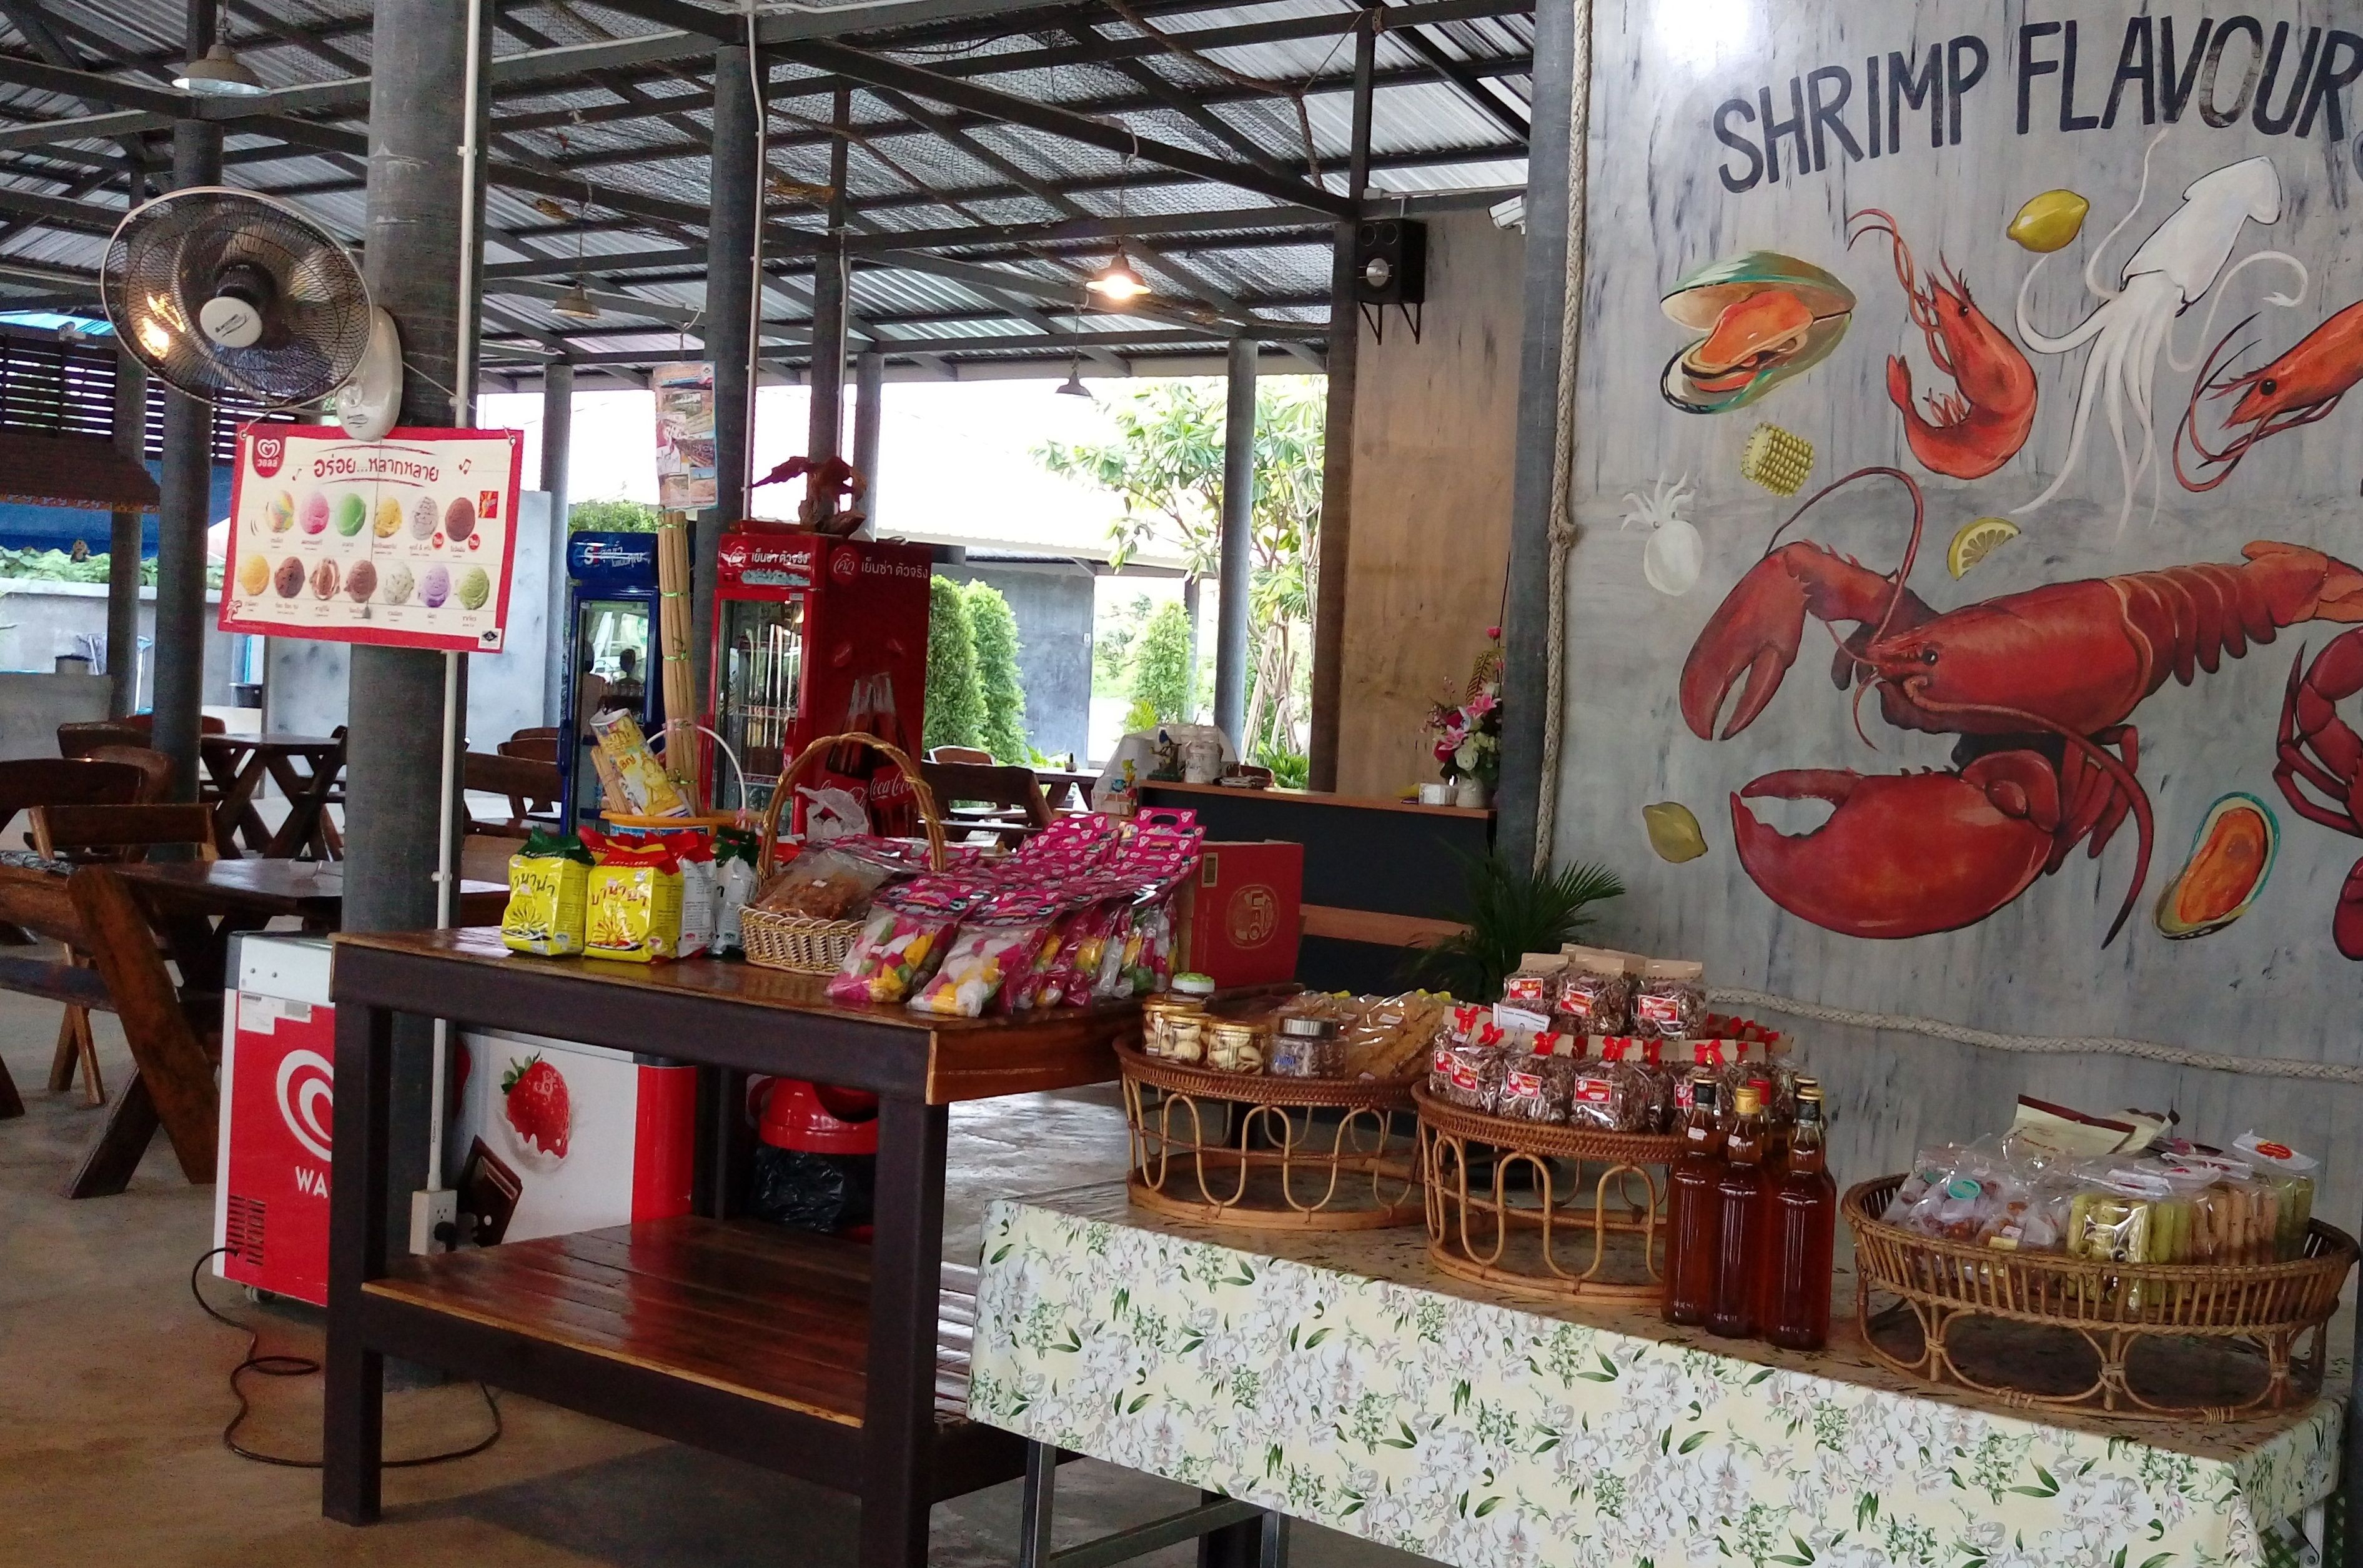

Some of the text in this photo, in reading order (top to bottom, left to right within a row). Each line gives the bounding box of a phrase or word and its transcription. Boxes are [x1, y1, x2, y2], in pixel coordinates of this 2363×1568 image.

[1713, 15, 2363, 194] SHRIMP FLAVOUR
[861, 556, 893, 575] เย็นซ่า
[896, 563, 928, 578] ตัวจริง
